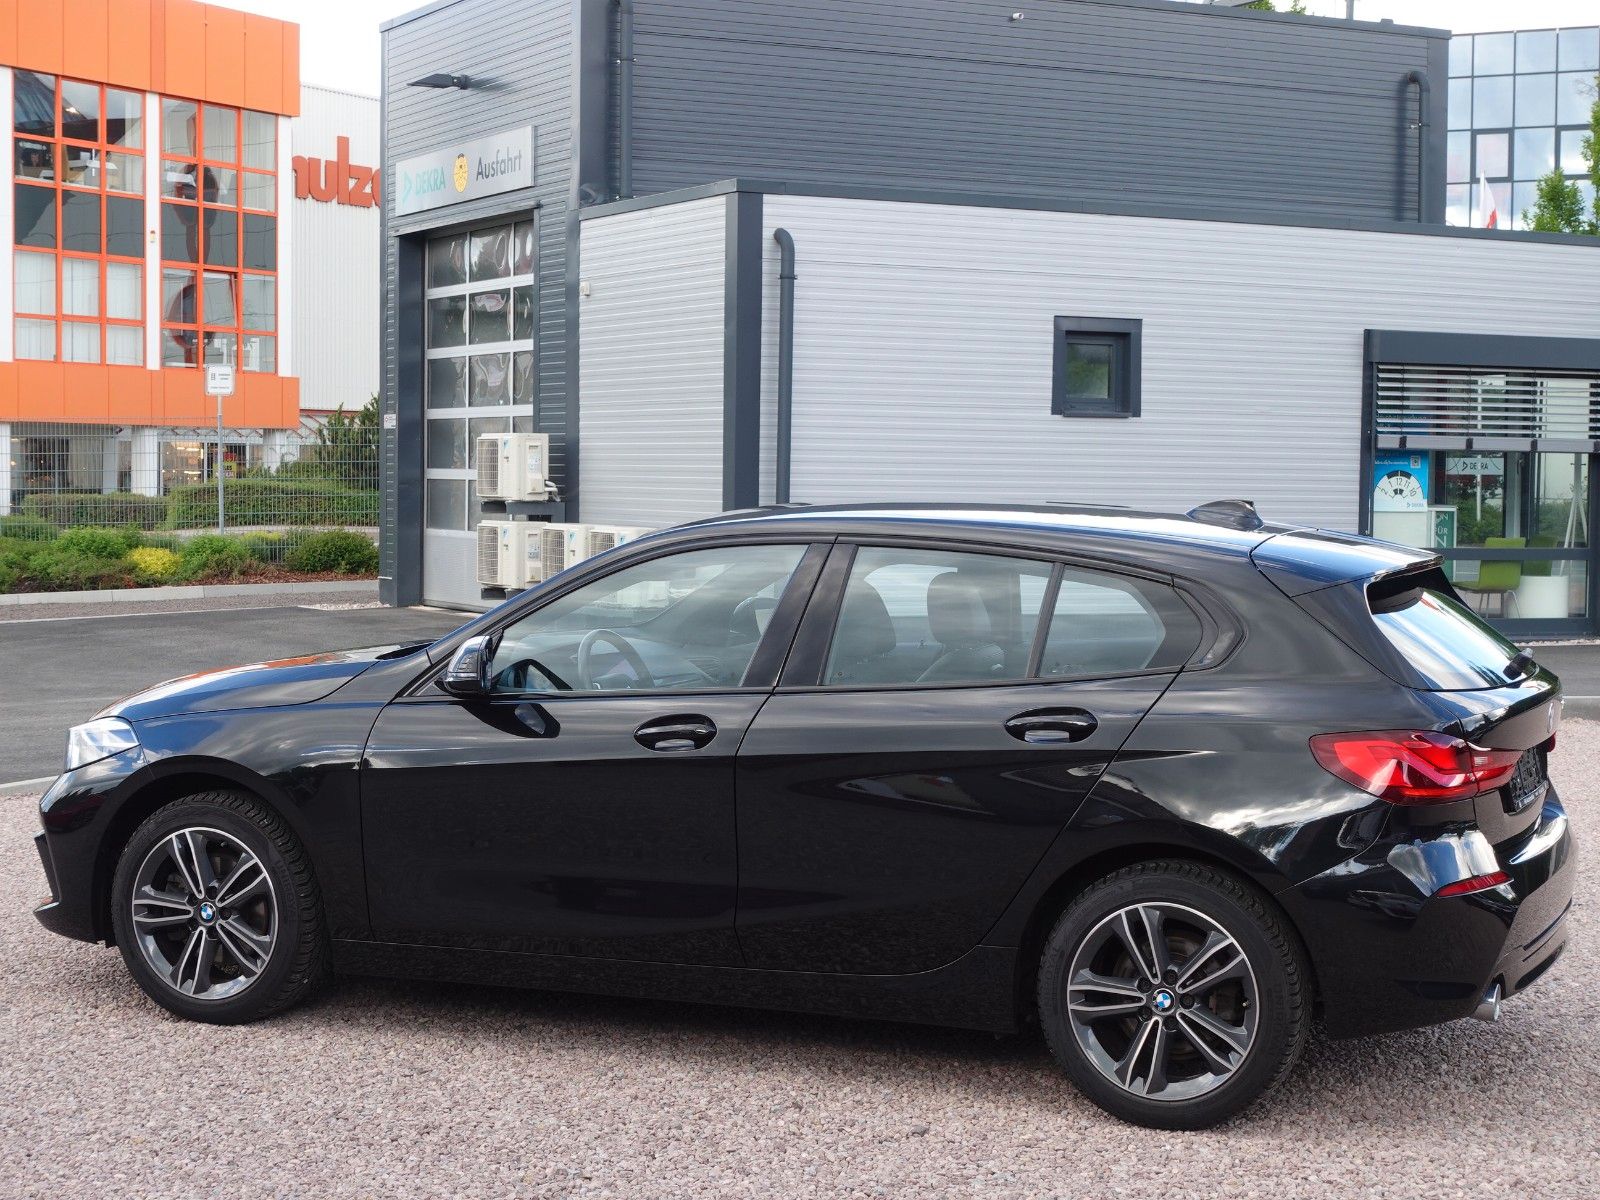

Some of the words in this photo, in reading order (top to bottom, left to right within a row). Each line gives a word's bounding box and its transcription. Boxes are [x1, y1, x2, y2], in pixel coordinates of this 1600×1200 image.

[415, 166, 446, 195] DEKRA
[476, 146, 521, 181] Ausfahrt
[1469, 462, 1488, 470] DERA
[1396, 477, 1403, 486] 12
